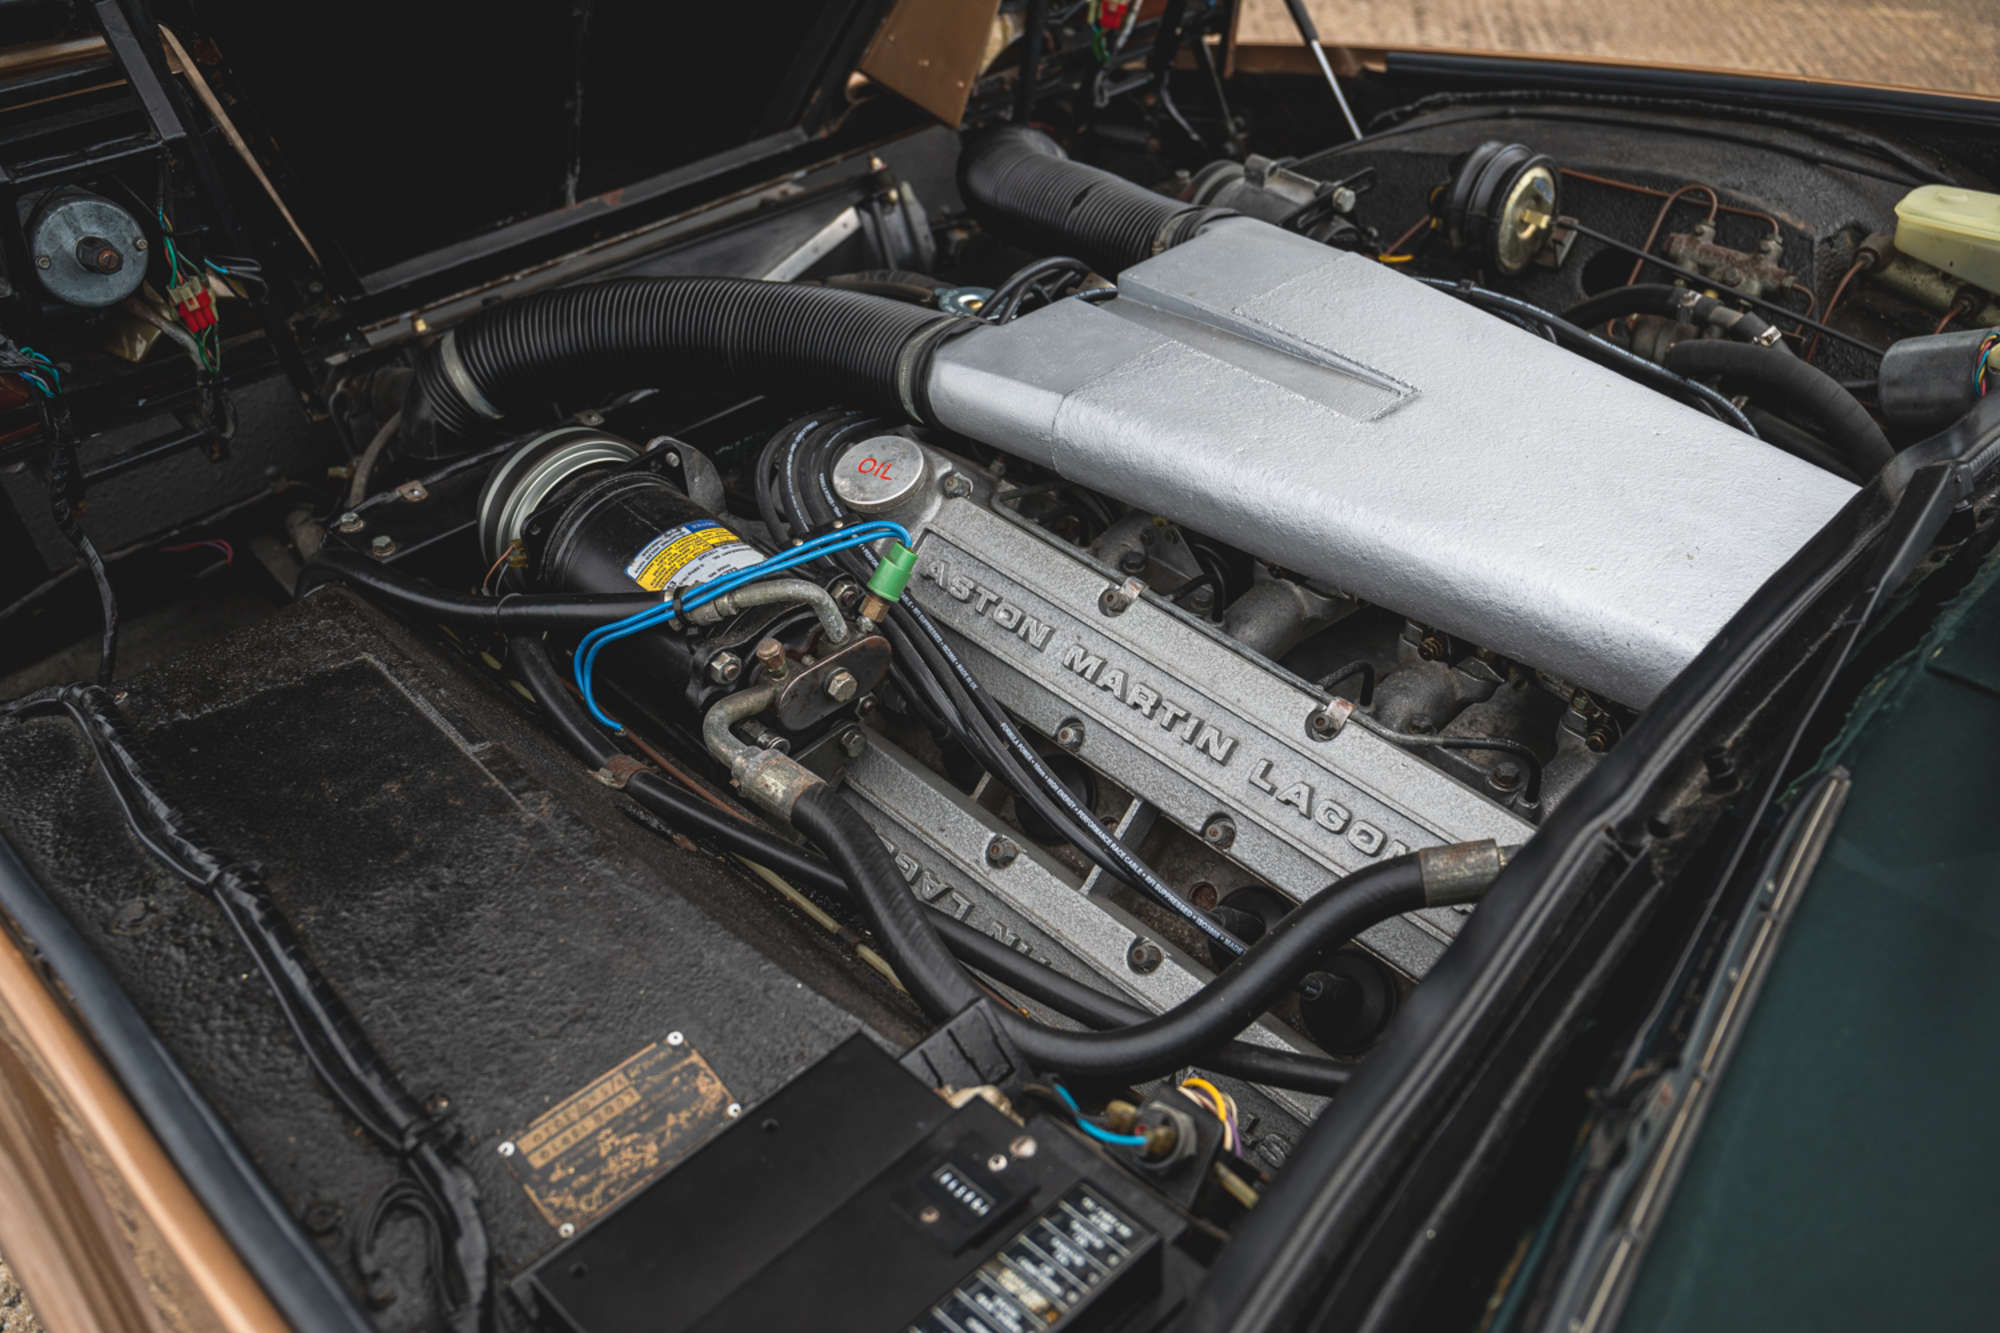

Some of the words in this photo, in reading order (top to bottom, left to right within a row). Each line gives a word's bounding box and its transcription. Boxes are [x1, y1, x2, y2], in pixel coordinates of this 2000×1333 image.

[858, 457, 892, 481] OIL
[921, 559, 1055, 651] ASTON
[1063, 644, 1238, 766] MARTIN
